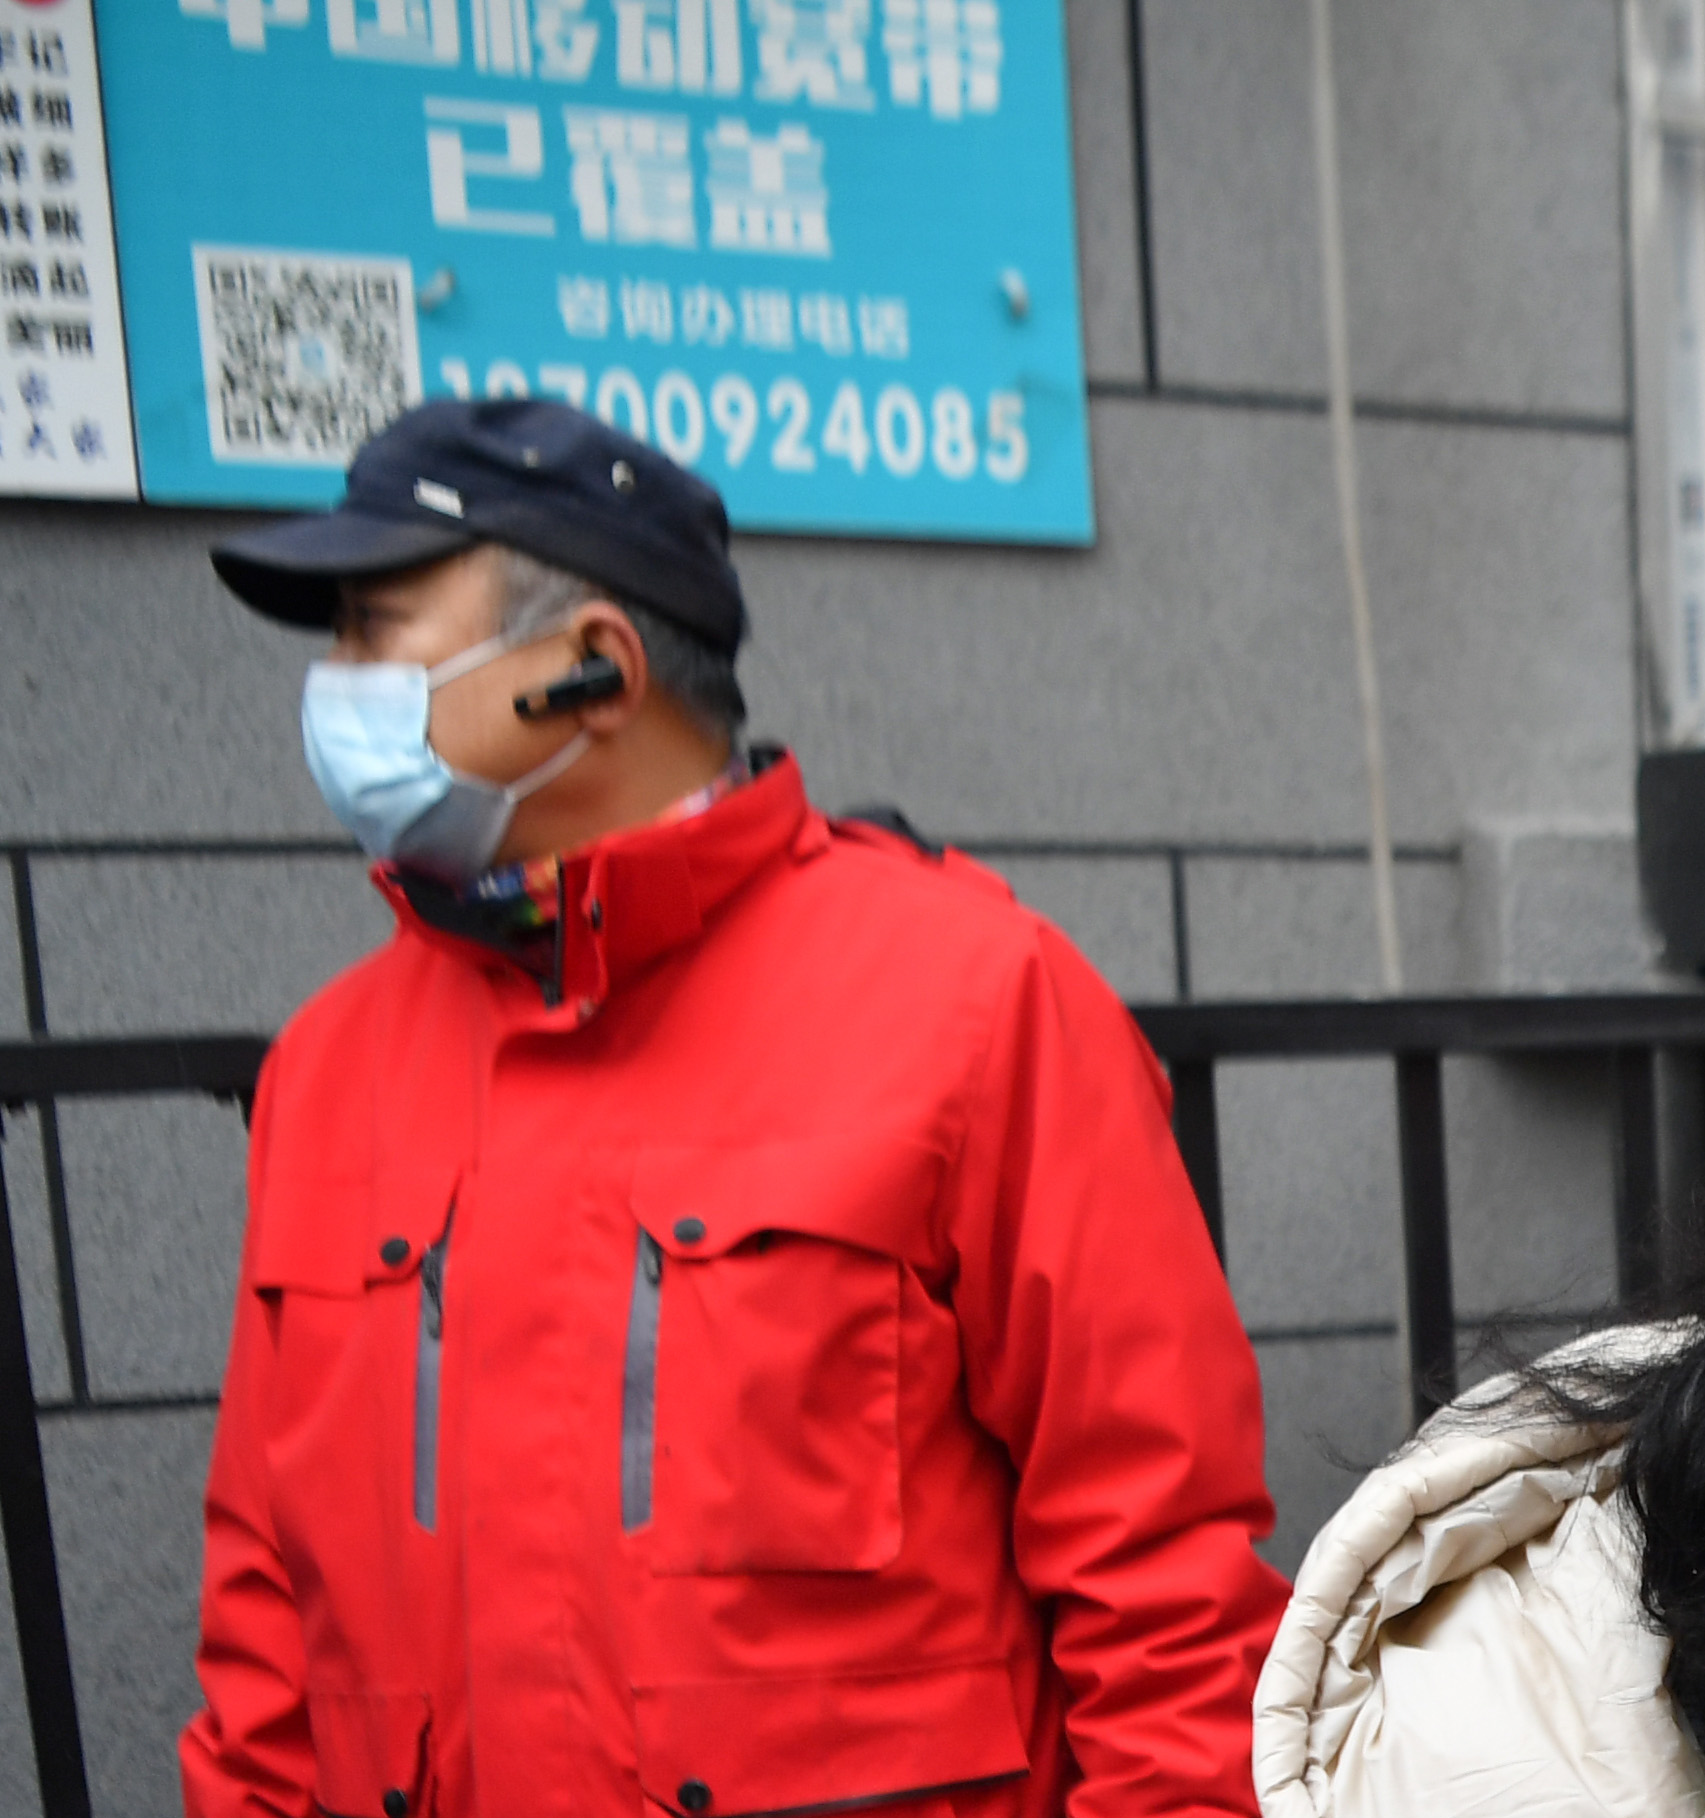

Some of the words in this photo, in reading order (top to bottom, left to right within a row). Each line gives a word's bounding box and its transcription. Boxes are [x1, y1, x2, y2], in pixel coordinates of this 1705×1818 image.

[423, 94, 834, 257] 已覆盖
[555, 271, 911, 361] 咨询办理电话
